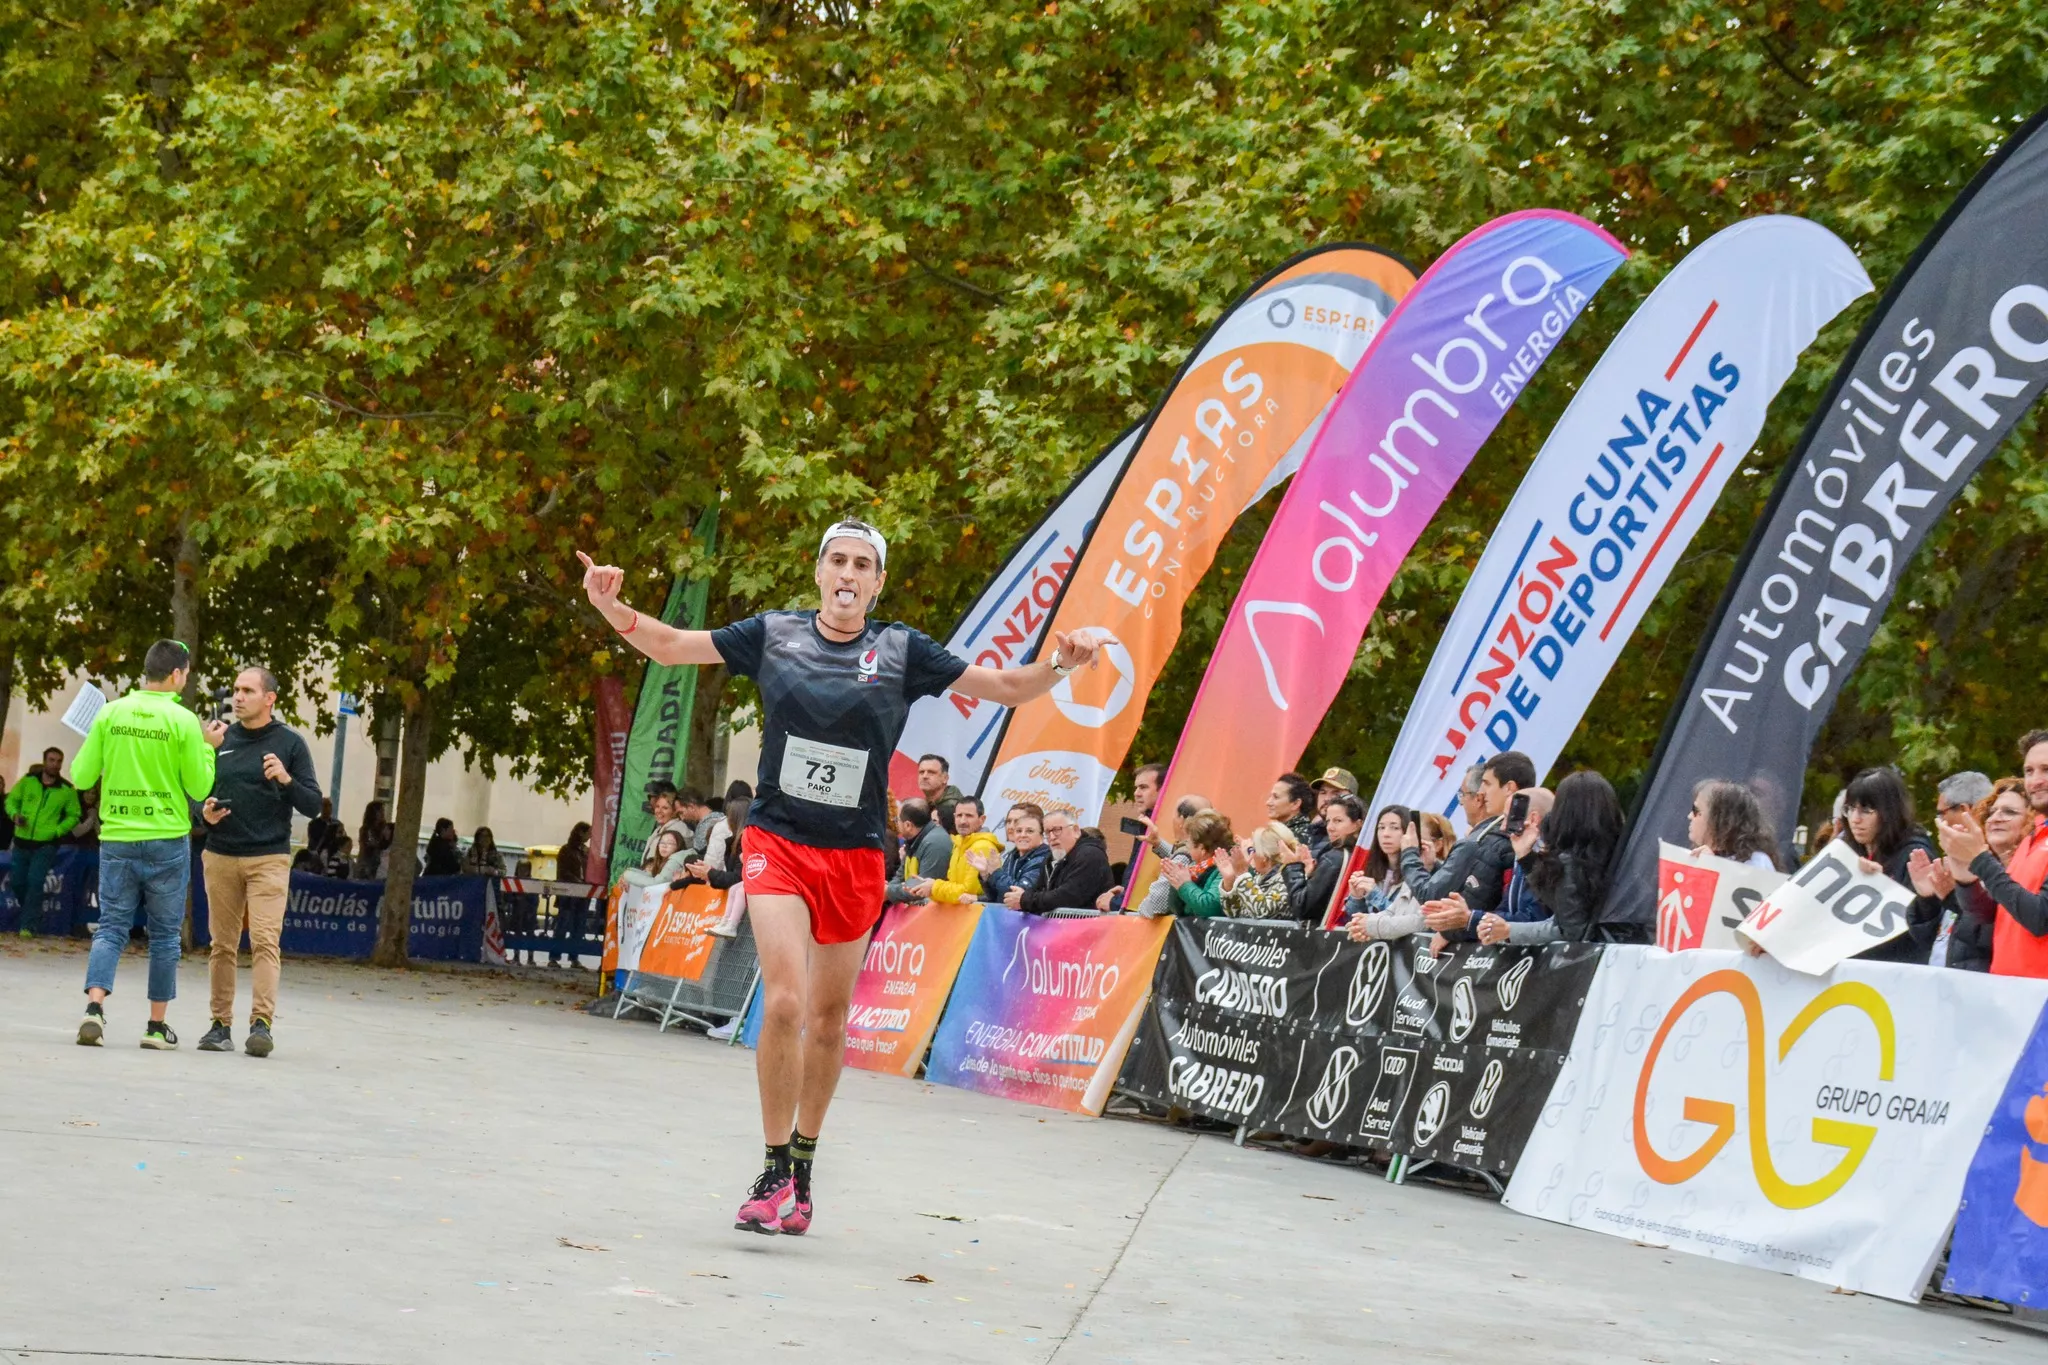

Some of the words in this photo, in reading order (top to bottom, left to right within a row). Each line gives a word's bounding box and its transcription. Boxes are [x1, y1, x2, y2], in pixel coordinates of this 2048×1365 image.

[1489, 285, 1588, 410] ENERGÍA
[1312, 255, 1563, 592] alumbra
[1103, 357, 1264, 608] ESPIAS
[1784, 284, 2048, 711] CABRERO
[1143, 397, 1279, 619] CONSRUCTORA
[1700, 317, 1936, 735] Automóviles
[1484, 673, 1541, 753] DE
[1528, 351, 1741, 683] DEPORTISTAS
[1432, 535, 1579, 780] MONZÓN
[1568, 388, 1672, 536] CUNA
[110, 725, 170, 742] ORGANIZACIÓN
[806, 760, 836, 784] 73
[807, 782, 832, 793] PAKO
[1028, 758, 1080, 789] Juntos
[286, 888, 369, 918] Nicolás
[284, 917, 338, 932] centro
[347, 920, 367, 933] de
[863, 930, 925, 976] mbra
[1202, 929, 1291, 969] Automóviles
[1462, 954, 1495, 971] ŠKODA
[1195, 967, 1289, 1019] CABRERO
[1398, 995, 1428, 1011] Audi
[965, 1020, 1020, 1052] ENERGÍA
[1395, 1010, 1426, 1029] Service
[1169, 1018, 1261, 1064] Automóviles
[1432, 1054, 1465, 1074] ŠKODA
[1168, 1055, 1265, 1117] CABRERO
[1815, 1084, 1883, 1118] GRUPO
[1885, 1094, 1951, 1126] GRACIA
[1593, 1207, 1635, 1226] Fabricación
[1635, 1218, 1646, 1229] de
